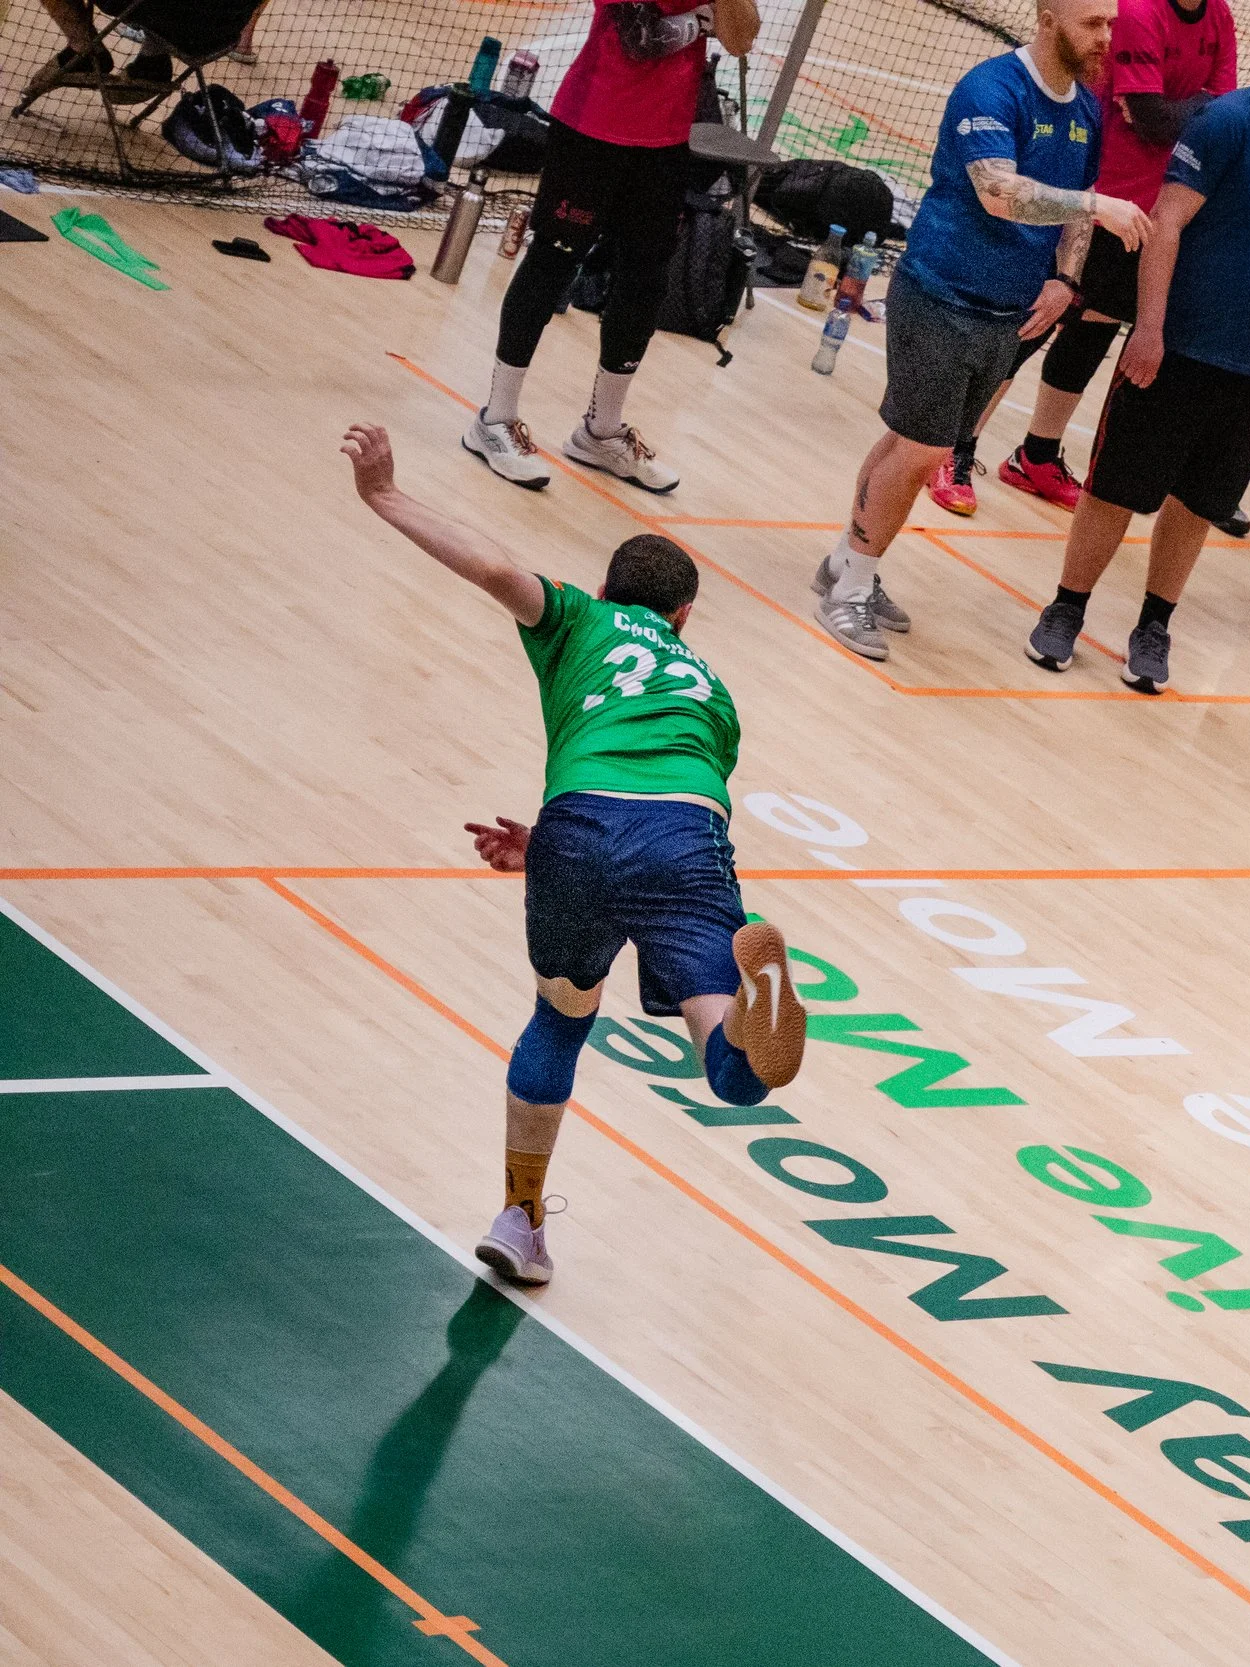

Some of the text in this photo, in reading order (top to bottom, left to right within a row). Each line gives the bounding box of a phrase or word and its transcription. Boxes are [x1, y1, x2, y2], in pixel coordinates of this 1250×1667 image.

[740, 791, 1192, 1058] More
[743, 912, 1029, 1109] Mo
[588, 1016, 1070, 1322] More
